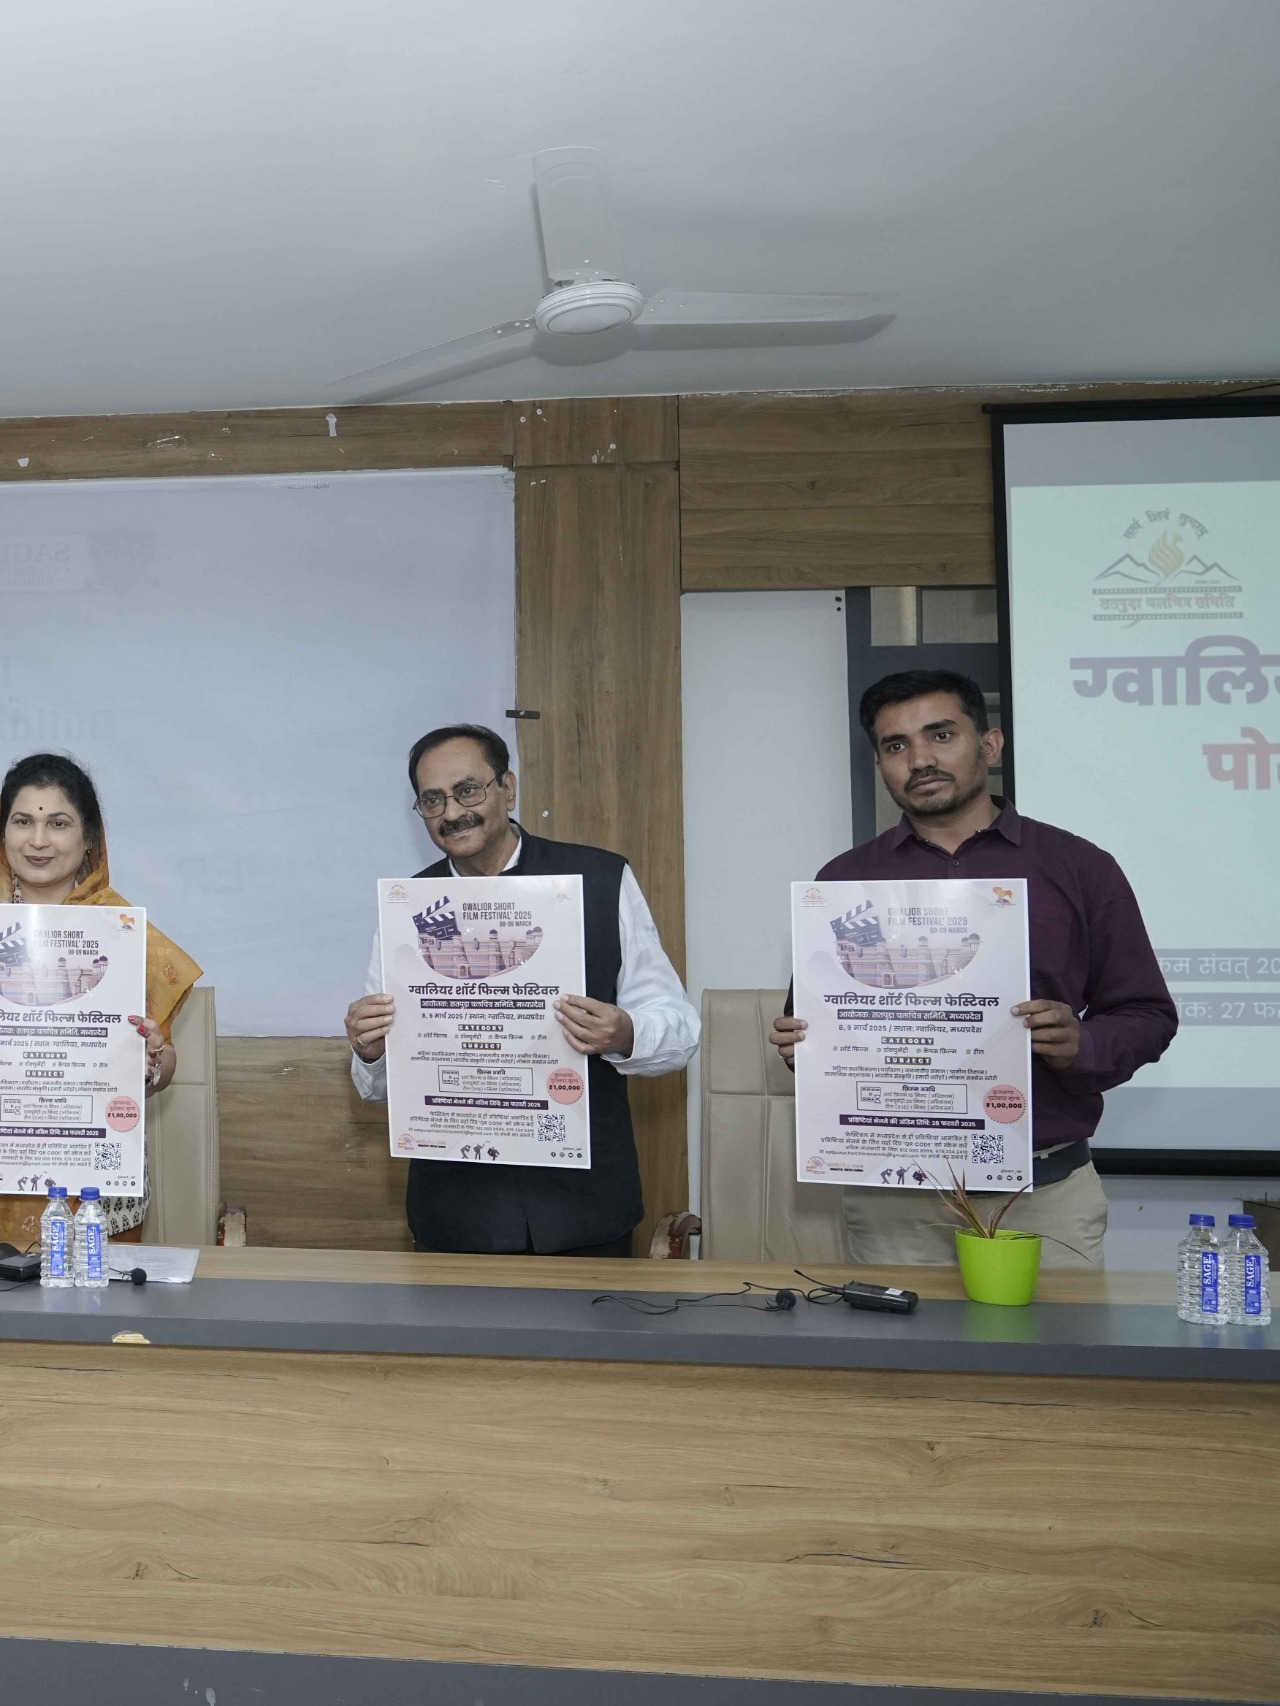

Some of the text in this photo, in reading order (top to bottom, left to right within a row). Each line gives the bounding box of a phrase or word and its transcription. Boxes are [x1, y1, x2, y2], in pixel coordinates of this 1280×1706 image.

[1070, 635, 1280, 706] ग्वालि
[463, 912, 478, 920] FILM
[888, 908, 947, 916] GWALIOR SHORT
[888, 917, 906, 926] FILM
[947, 917, 967, 925] 2025
[82, 940, 98, 948] 2025
[409, 982, 559, 995] ग्वालियर शॉर्ट फिल्म फेस्टिवल
[824, 991, 999, 1007] ग्वालियर शॉर्ट फिल्म फेस्टिवल
[23, 1009, 43, 1023] शॉर्ट
[45, 1010, 75, 1023] फिल्म
[78, 1010, 121, 1023] फेस्टिवल
[1221, 1002, 1245, 1019] 27
[1204, 1257, 1212, 1284] SAGE
[1246, 1260, 1255, 1287] SAGE
